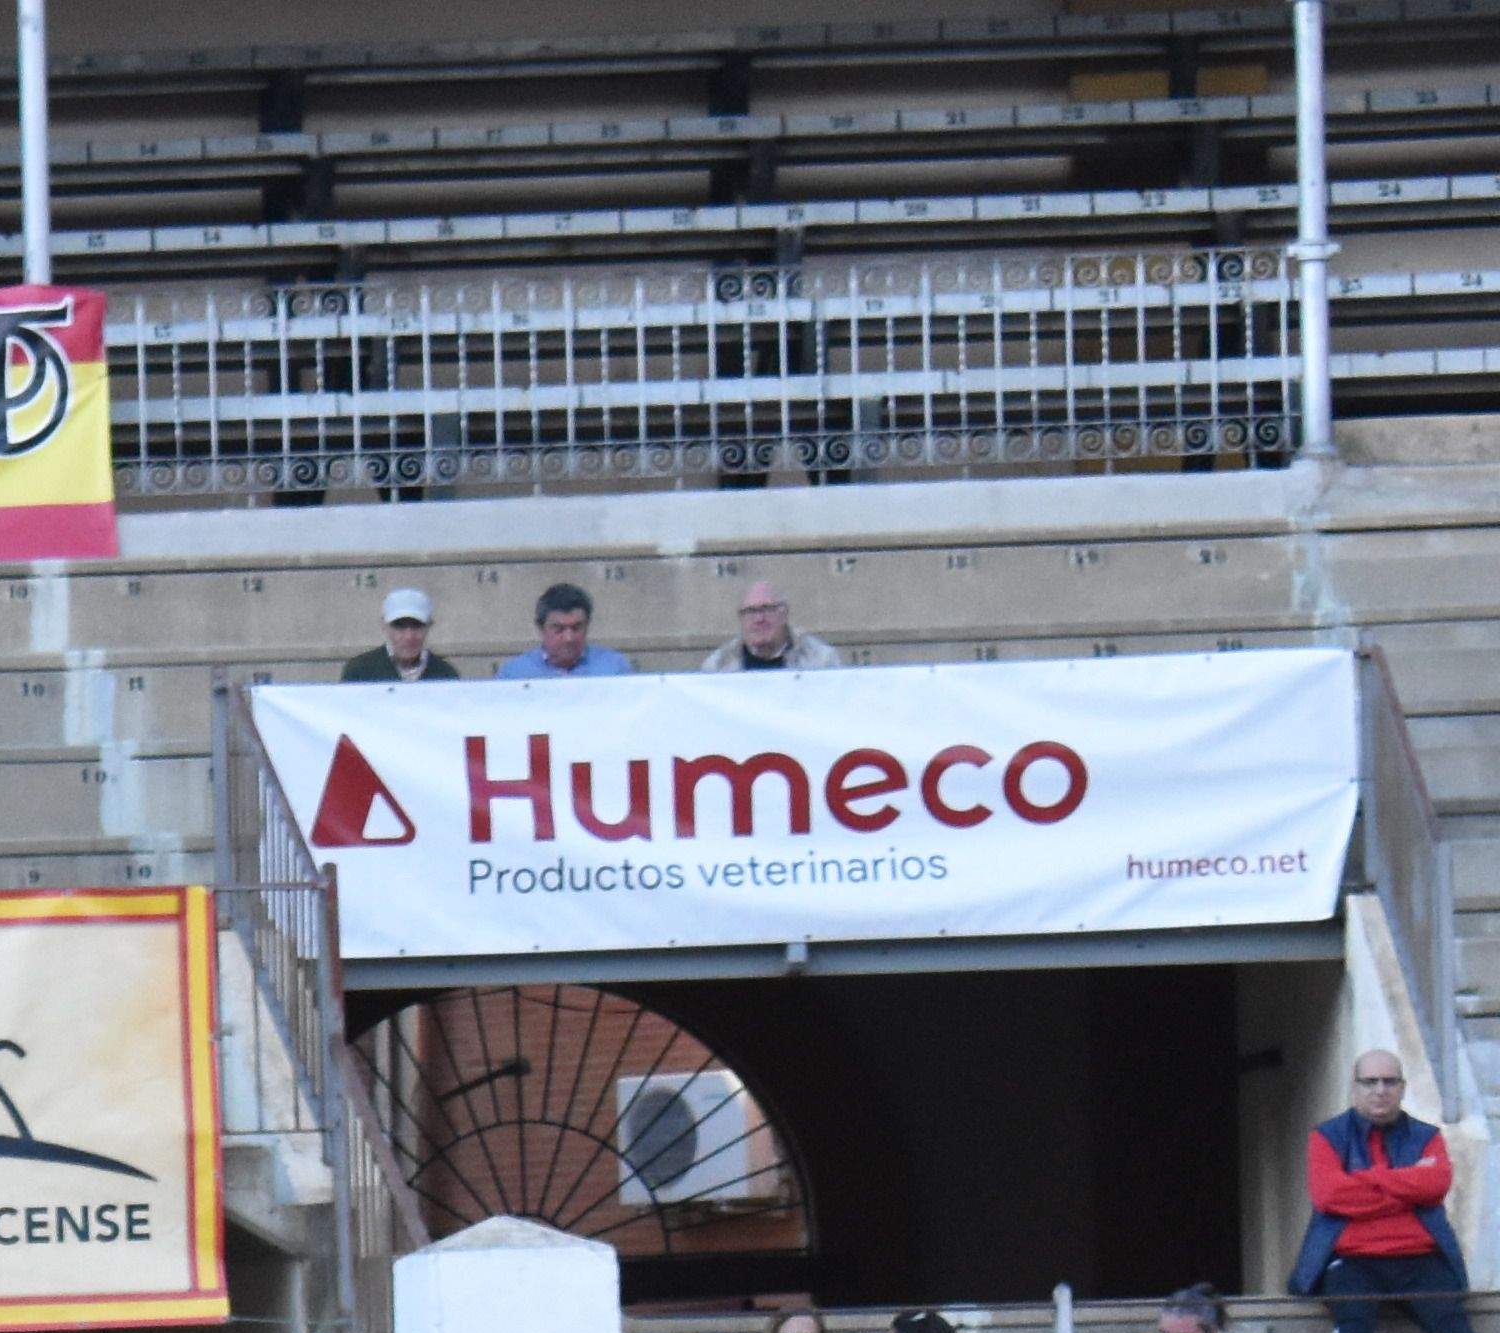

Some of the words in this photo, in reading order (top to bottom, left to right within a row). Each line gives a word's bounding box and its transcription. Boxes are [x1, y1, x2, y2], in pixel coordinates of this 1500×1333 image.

[466, 733, 1089, 844] Humeco
[469, 856, 685, 896] Productos
[699, 849, 948, 888] veterinarios
[1125, 849, 1308, 880] humeco.net
